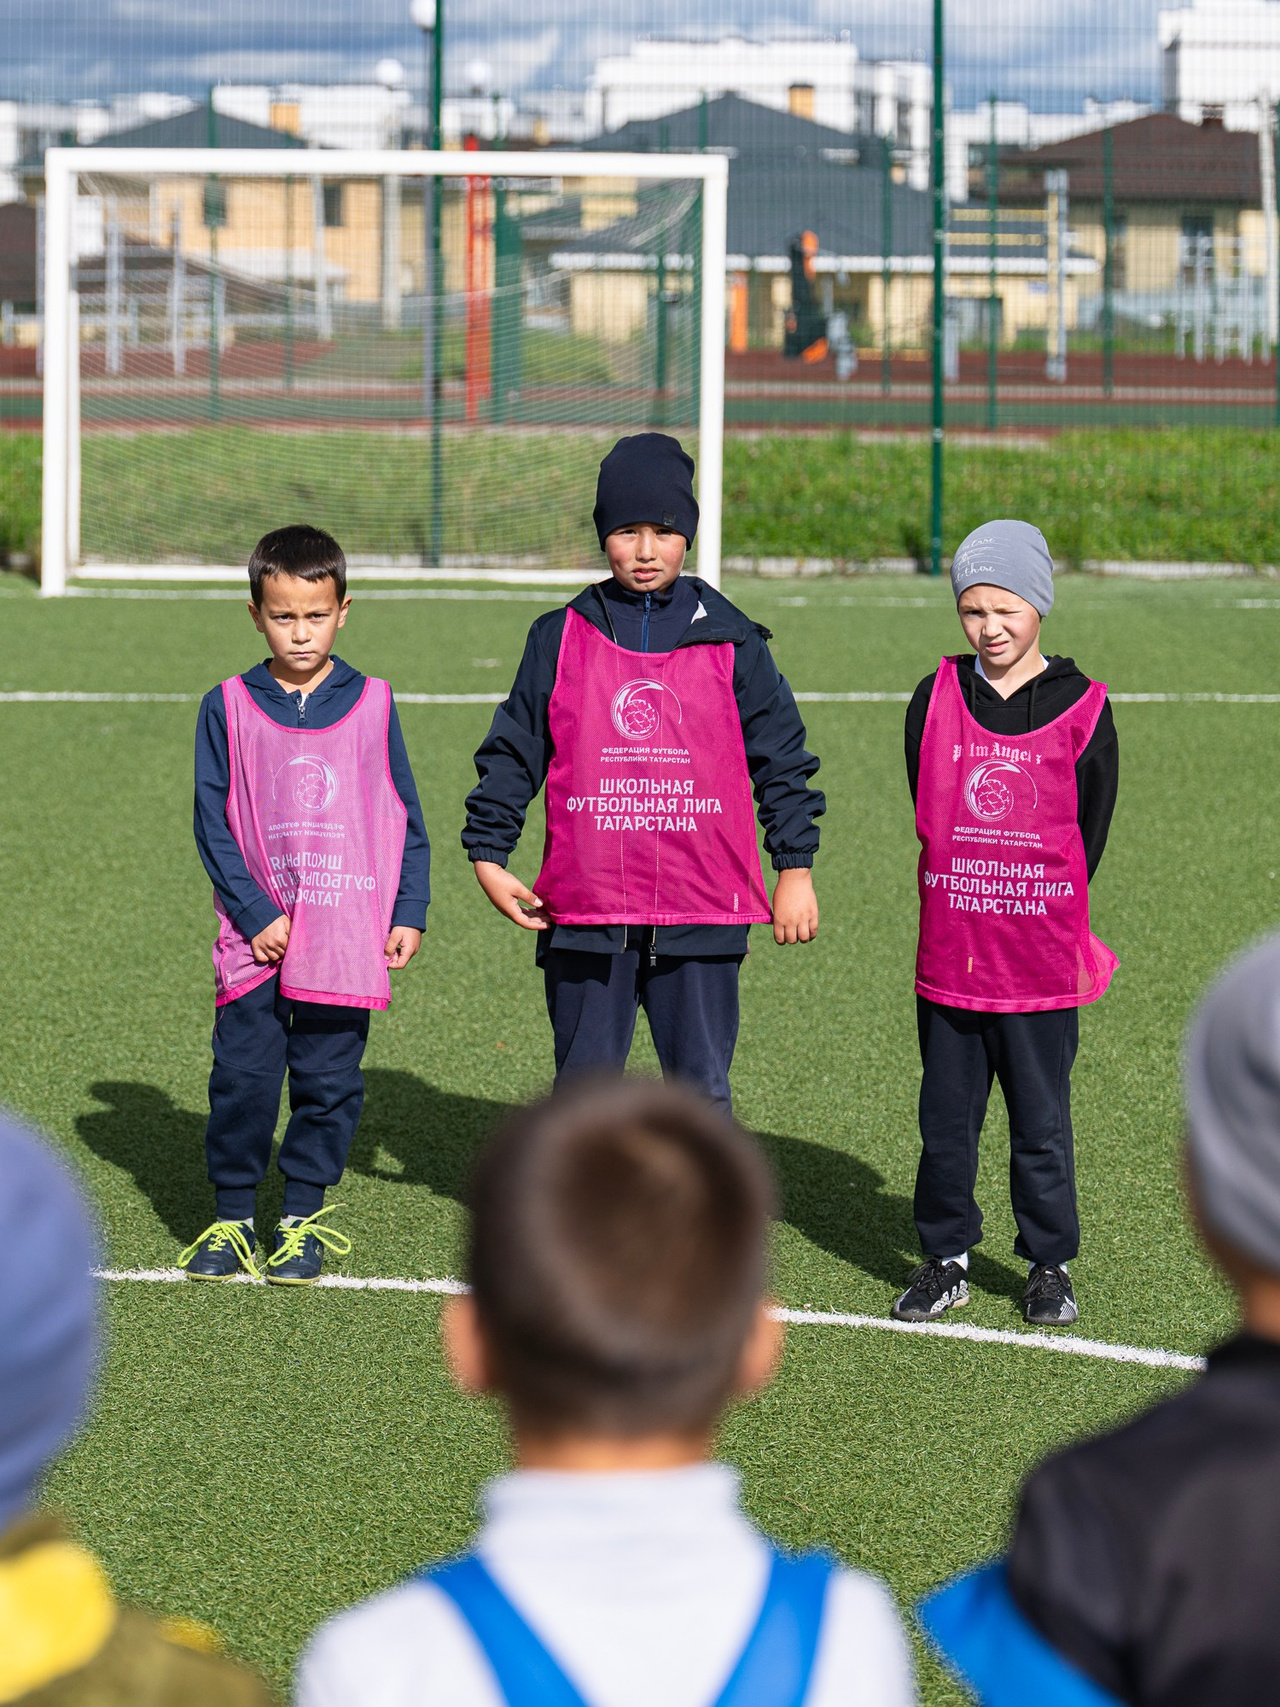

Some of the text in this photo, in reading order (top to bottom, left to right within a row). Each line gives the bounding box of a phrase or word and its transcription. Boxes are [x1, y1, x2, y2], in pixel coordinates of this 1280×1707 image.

[652, 747, 689, 755] ФУТБОЛА
[952, 742, 989, 763] Plm
[600, 778, 695, 795] ШКОЛЬНАЯ
[566, 796, 722, 813] ФУТБОЛЬНАЯ ЛИГА
[594, 815, 698, 832] ТАТАРСТАНА
[952, 835, 1043, 848] РЕСПУБЛИКИ ТАТАРСТАН
[954, 826, 1040, 840] ФЕДЕРАЦИЯ ФУТБОЛА
[951, 857, 1045, 879] ШКОЛЬНАЯ
[924, 871, 1074, 897] ФУТБОЛЬНАЯ ЛИГА
[948, 893, 1048, 915] ТАТАРСТАНА
